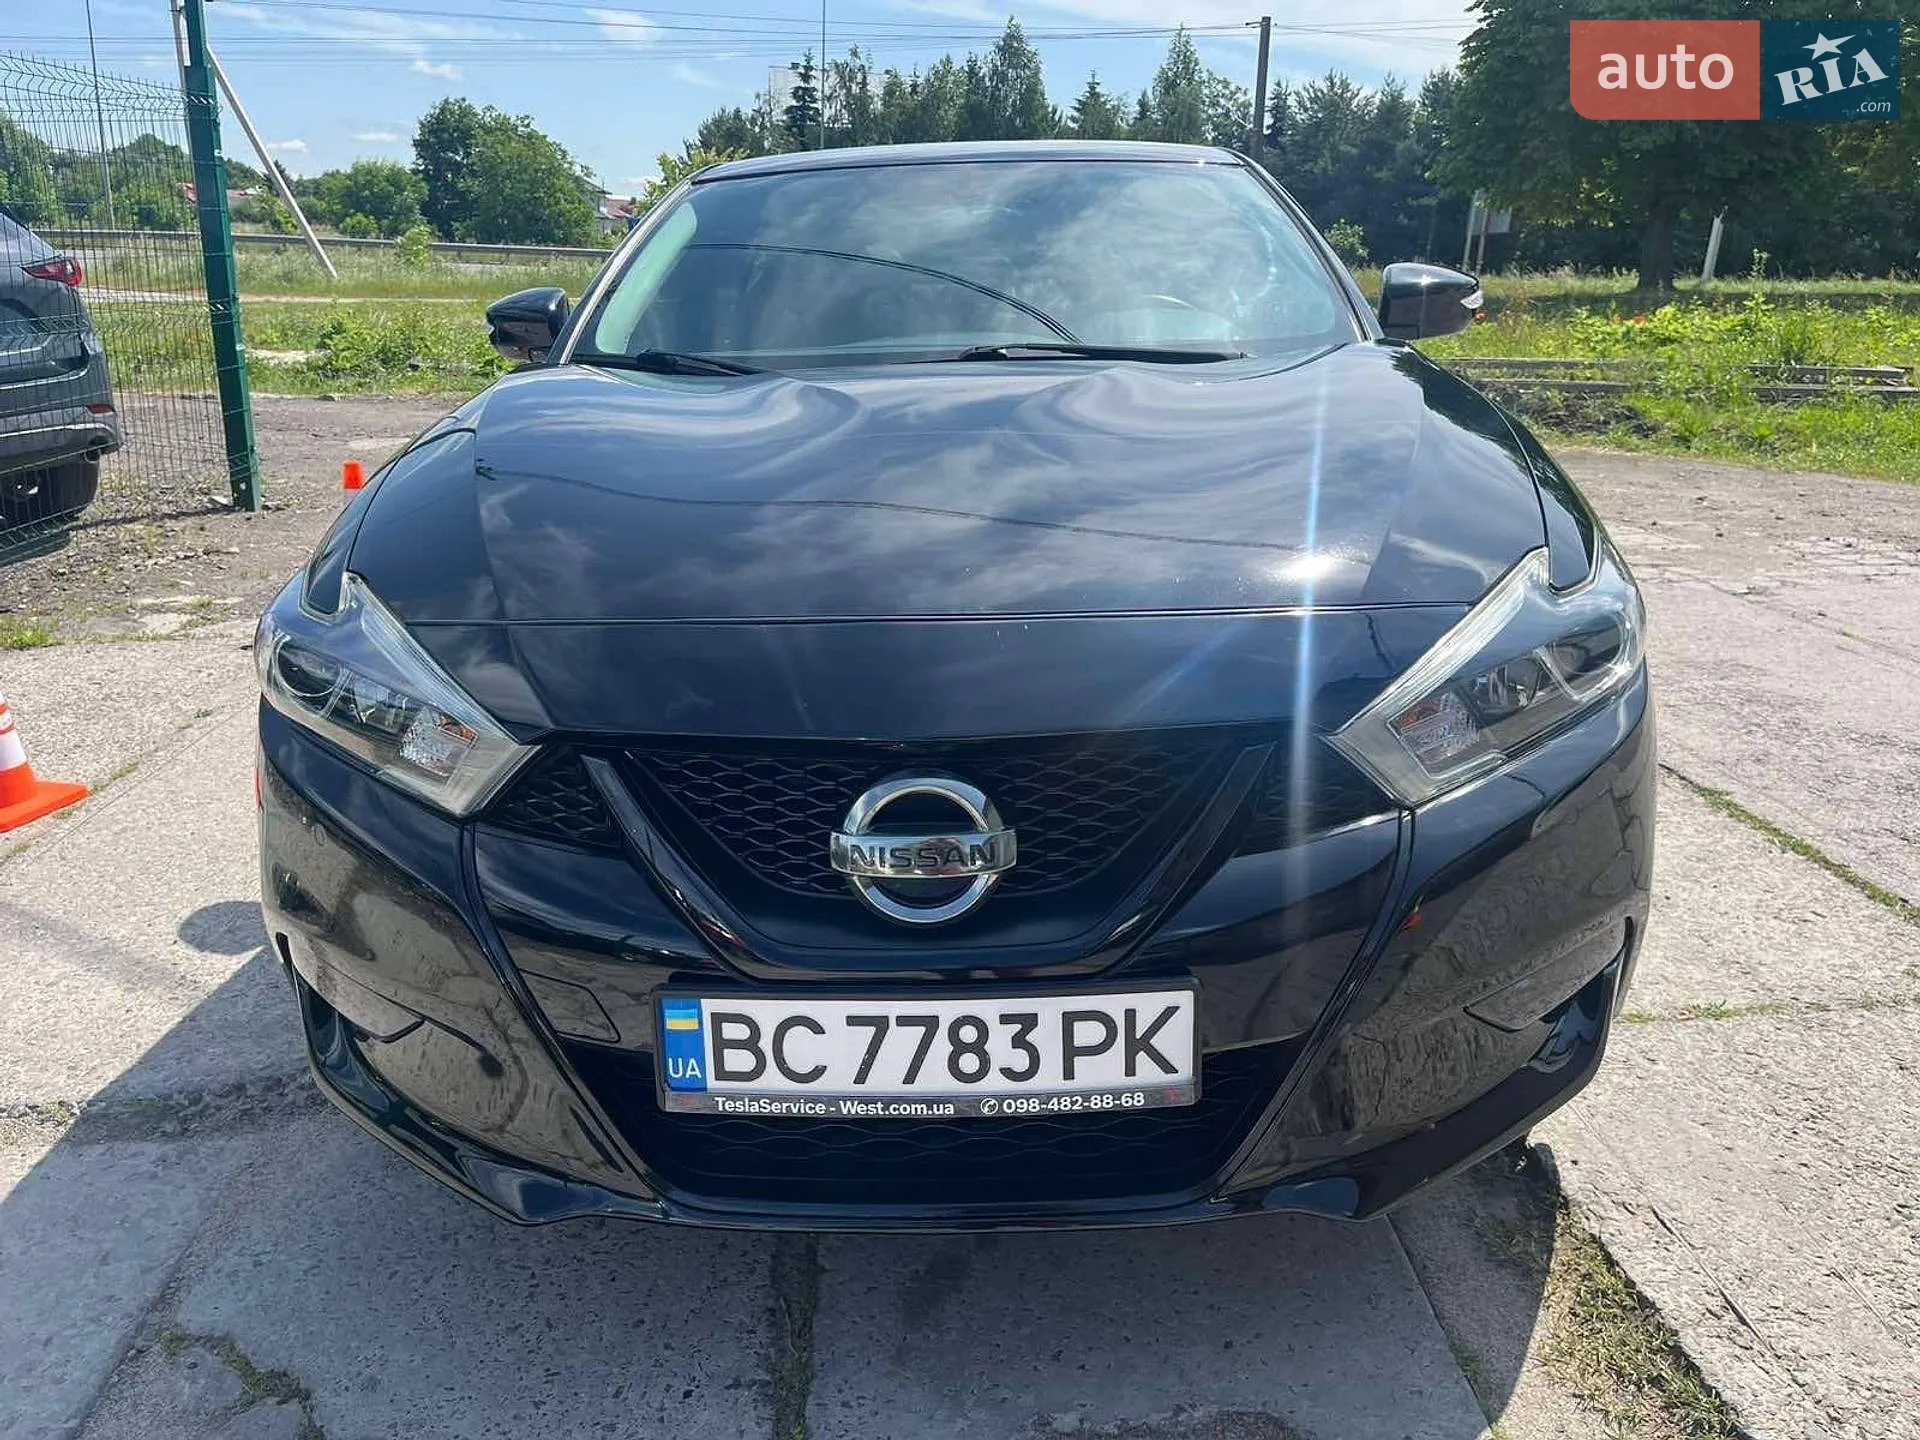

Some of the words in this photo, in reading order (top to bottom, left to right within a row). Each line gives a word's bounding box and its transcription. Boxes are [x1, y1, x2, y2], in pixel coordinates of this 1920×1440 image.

[849, 843, 996, 869] NISSAN
[710, 1011, 828, 1084] BC
[845, 1011, 1040, 1085] 7783
[1062, 1004, 1181, 1081] PK
[668, 1057, 702, 1080] UA
[714, 1097, 827, 1115] TeslaService
[839, 1099, 954, 1116] West.com.ua
[1003, 1091, 1145, 1112] 098-482-88-68
